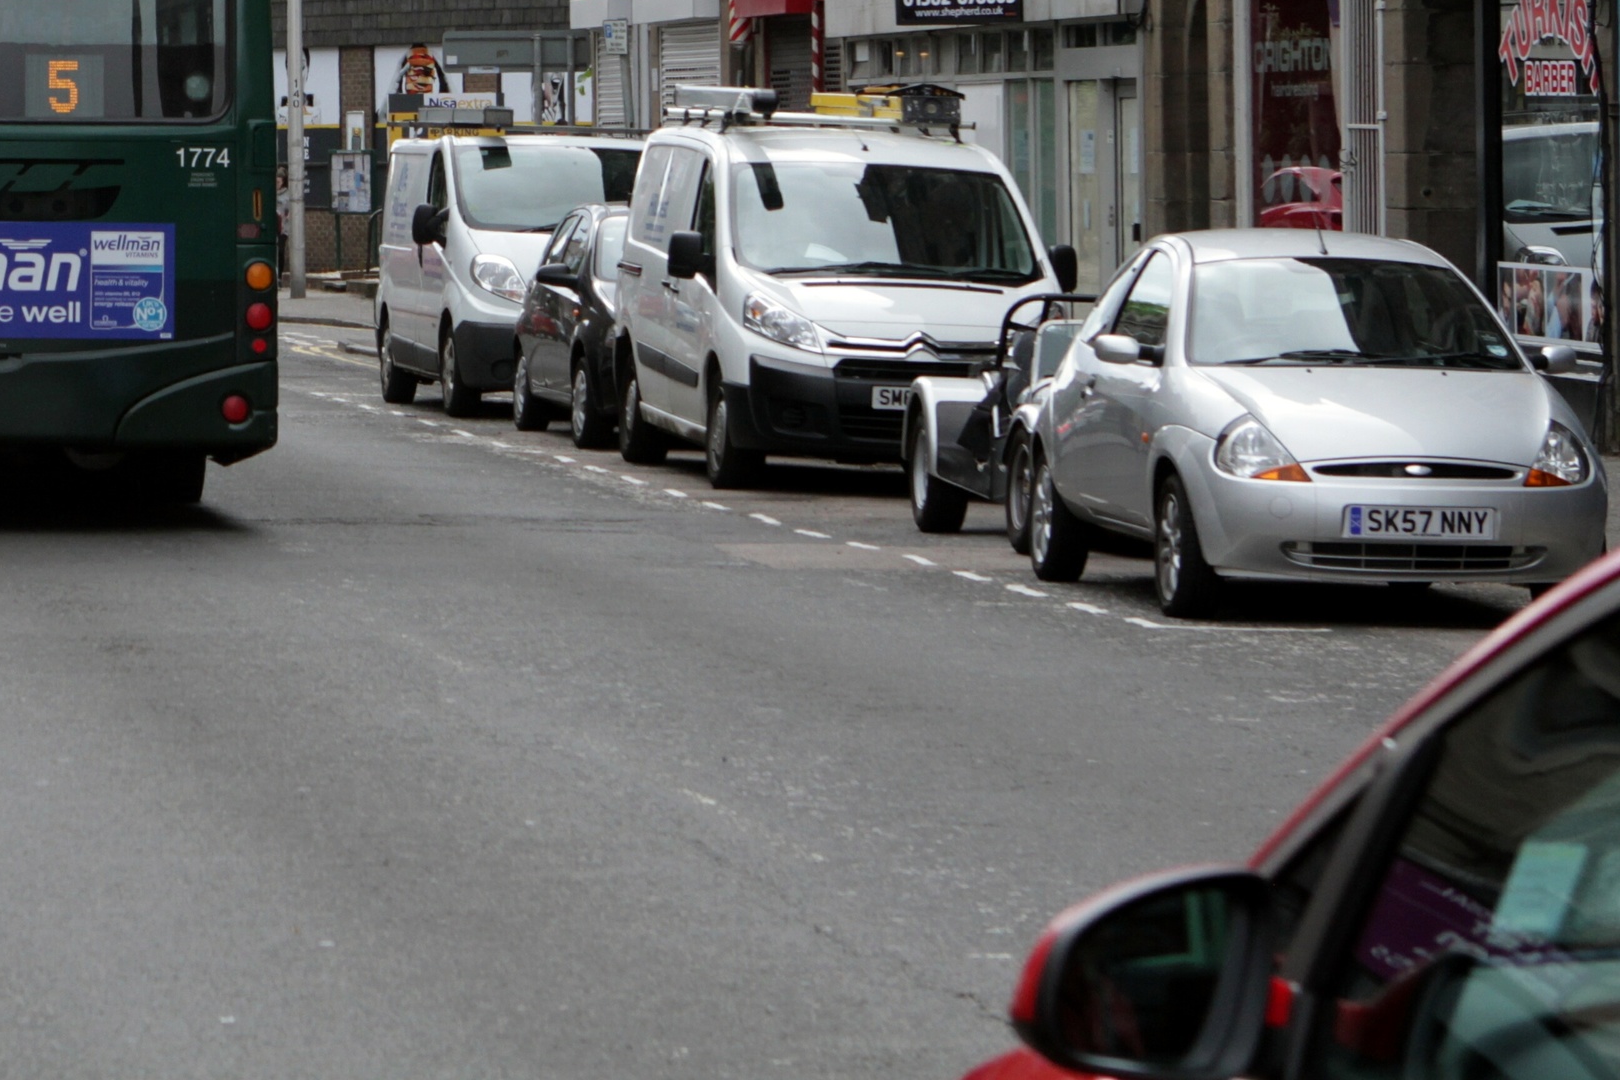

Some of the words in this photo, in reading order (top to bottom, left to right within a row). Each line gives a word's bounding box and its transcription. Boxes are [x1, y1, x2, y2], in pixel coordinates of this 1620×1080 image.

[914, 6, 1004, 18] www.shepherd.co.uk
[48, 60, 78, 113] 5
[1524, 61, 1577, 96] BARBER
[176, 148, 230, 168] 1774
[93, 234, 160, 251] wellman
[124, 280, 148, 288] vitality
[20, 301, 81, 324] well
[1368, 510, 1432, 533] SK57
[1440, 510, 1488, 534] NNY
